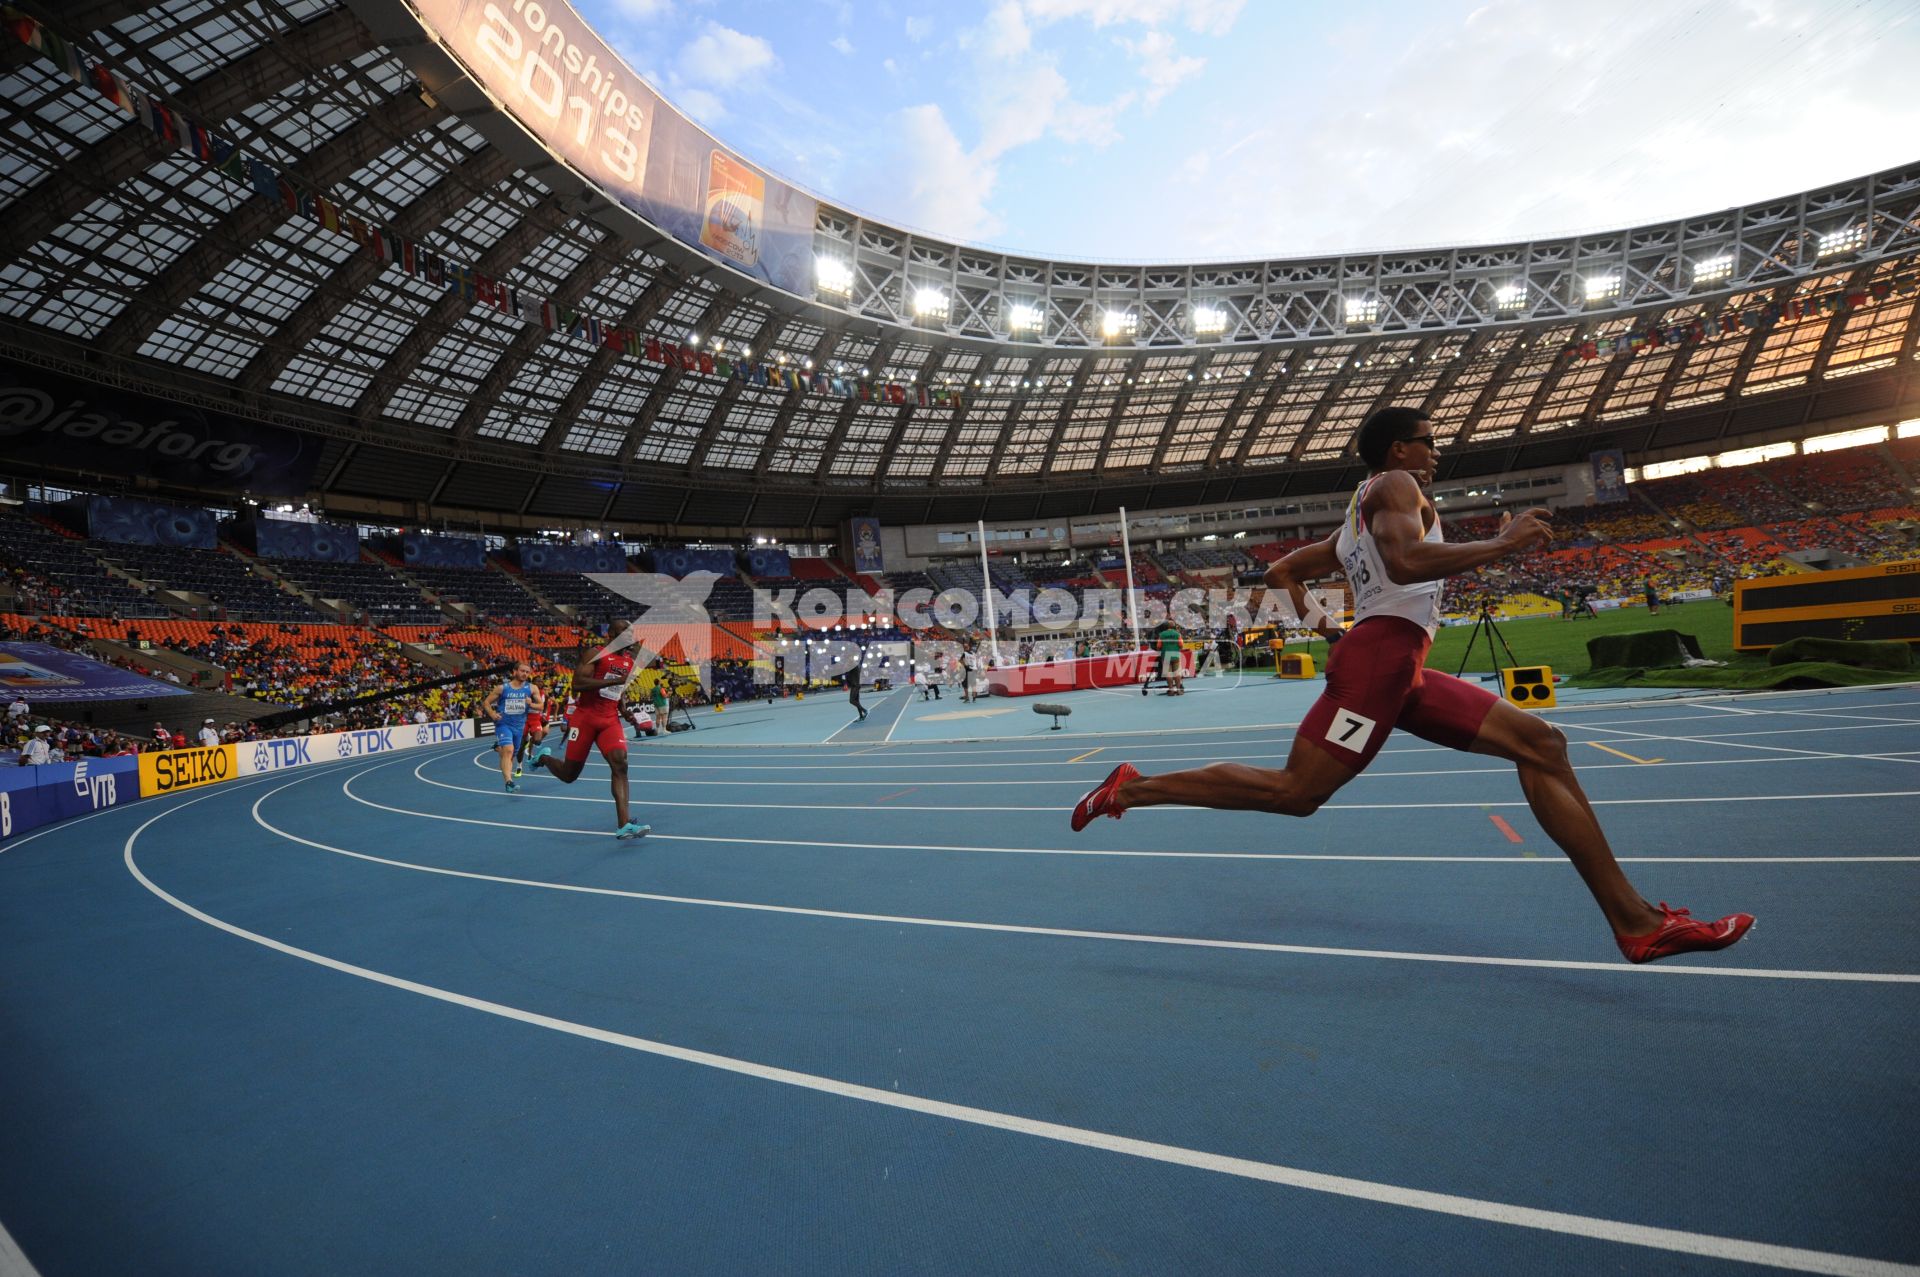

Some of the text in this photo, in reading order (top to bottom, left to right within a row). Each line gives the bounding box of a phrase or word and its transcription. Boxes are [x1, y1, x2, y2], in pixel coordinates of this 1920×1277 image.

[476, 3, 639, 183] 2013
[0, 386, 252, 471] @iaaforg
[626, 702, 656, 713] adidas
[351, 728, 393, 754] TDK
[427, 721, 465, 742] TDK
[571, 730, 577, 739] 6
[1339, 717, 1365, 742] 7
[268, 737, 312, 768] TDK
[156, 748, 228, 791] SEIKO
[90, 773, 117, 809] VTB
